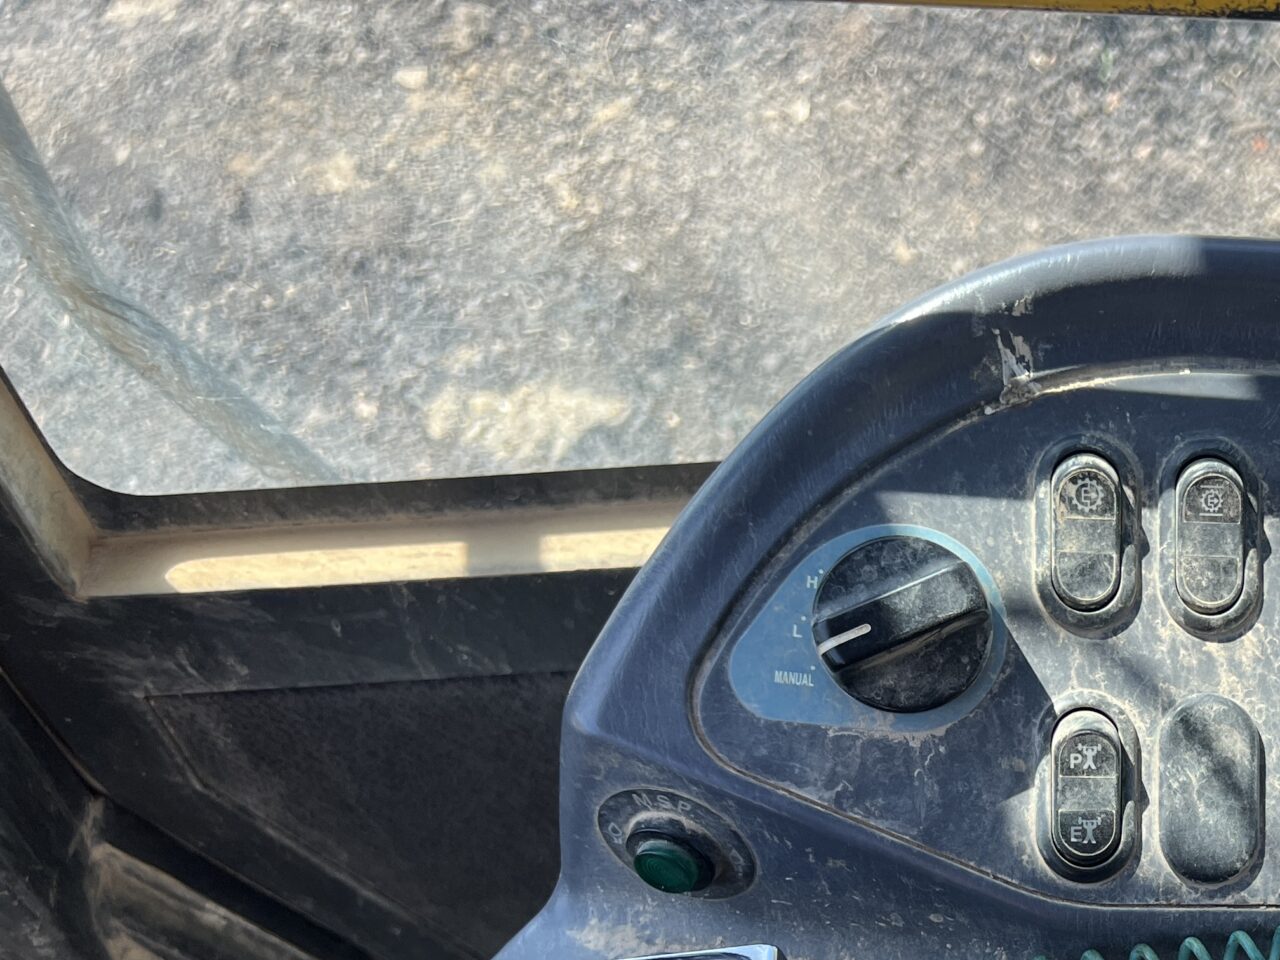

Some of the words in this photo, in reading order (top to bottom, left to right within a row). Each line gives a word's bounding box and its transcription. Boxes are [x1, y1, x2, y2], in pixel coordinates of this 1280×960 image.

[806, 575, 818, 589] H
[792, 624, 803, 638] L
[774, 670, 815, 687] MANUAL
[1069, 753, 1083, 769] P
[1070, 826, 1083, 842] E
